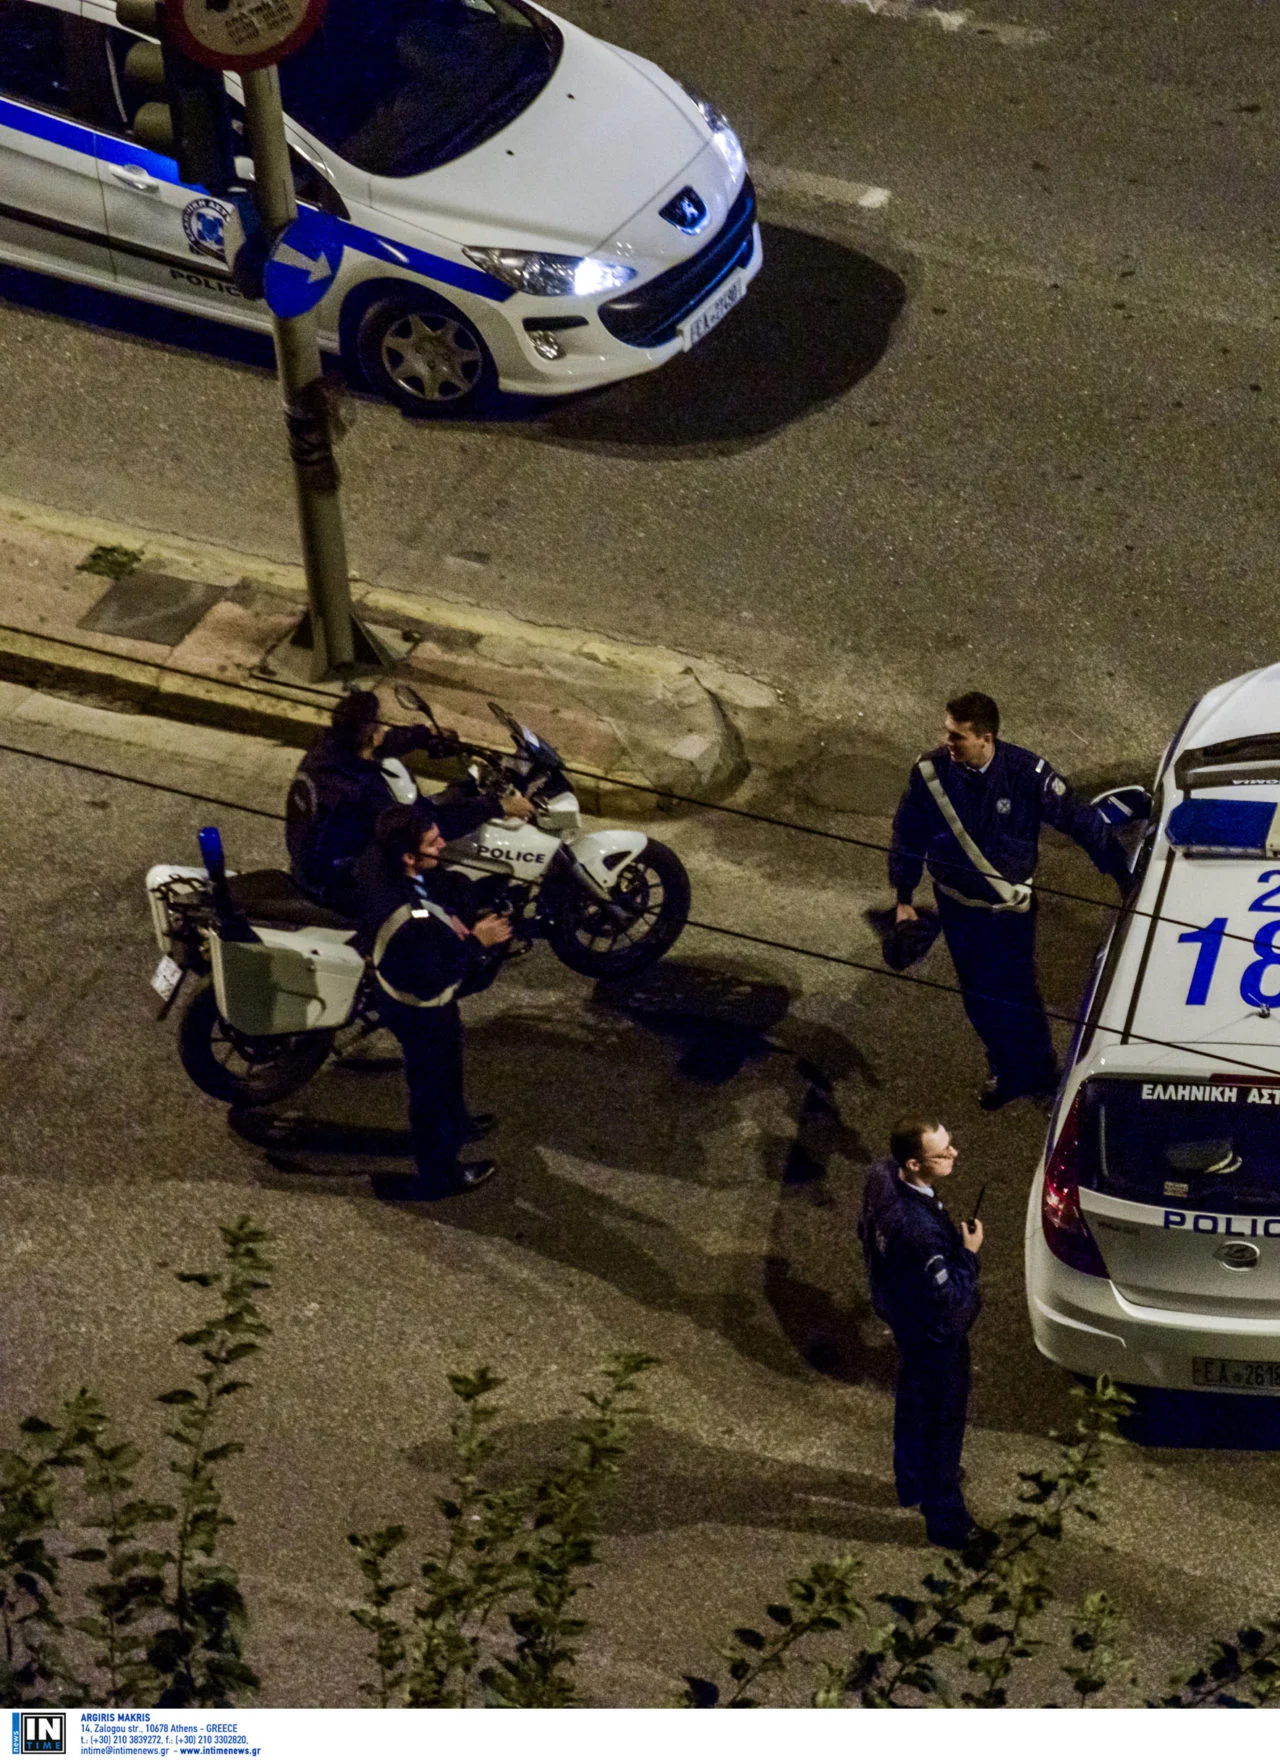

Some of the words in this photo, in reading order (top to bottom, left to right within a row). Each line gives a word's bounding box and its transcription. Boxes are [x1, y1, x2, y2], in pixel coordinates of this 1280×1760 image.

[169, 267, 241, 297] POLIC
[478, 845, 547, 864] POLICE
[1141, 1083, 1238, 1103] ΕΛΛΗΝΙΚΗ
